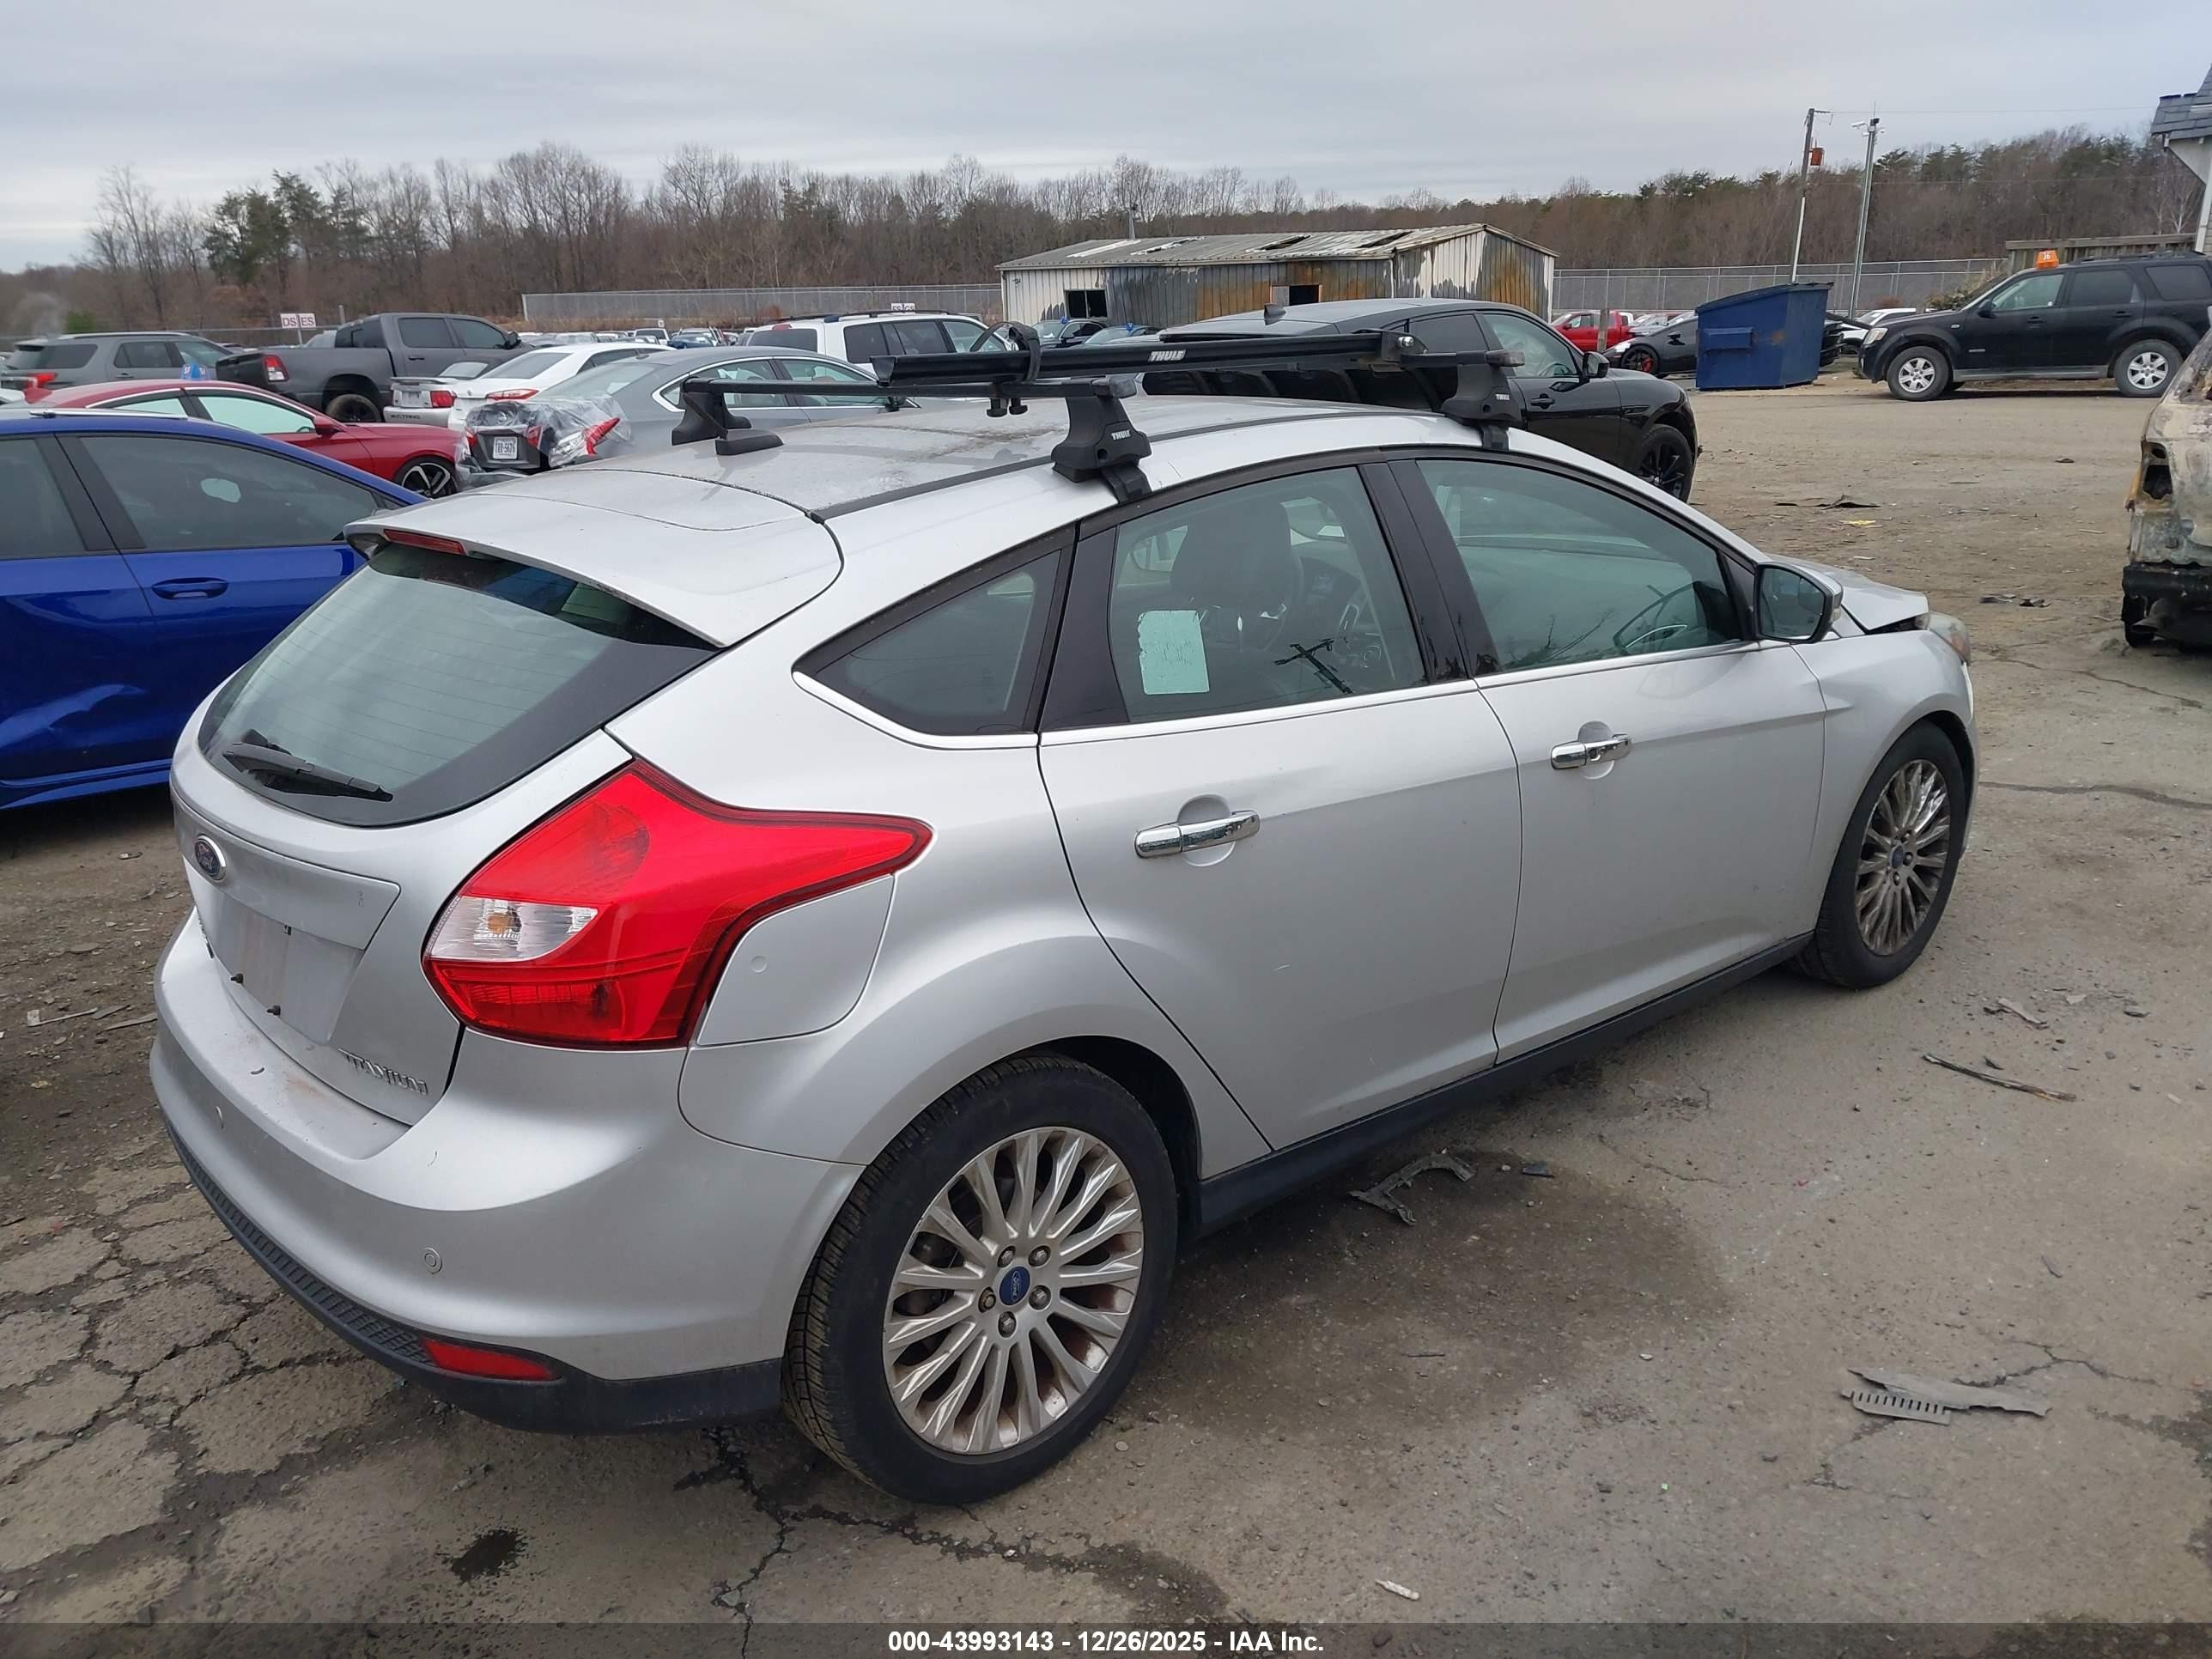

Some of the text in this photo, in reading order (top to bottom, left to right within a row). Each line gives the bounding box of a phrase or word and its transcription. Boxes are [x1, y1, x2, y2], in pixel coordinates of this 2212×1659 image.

[283, 317, 314, 326] DS ES
[1148, 349, 1187, 362] THULE
[1111, 429, 1132, 441] THULE
[337, 1048, 428, 1097] TITANIUM
